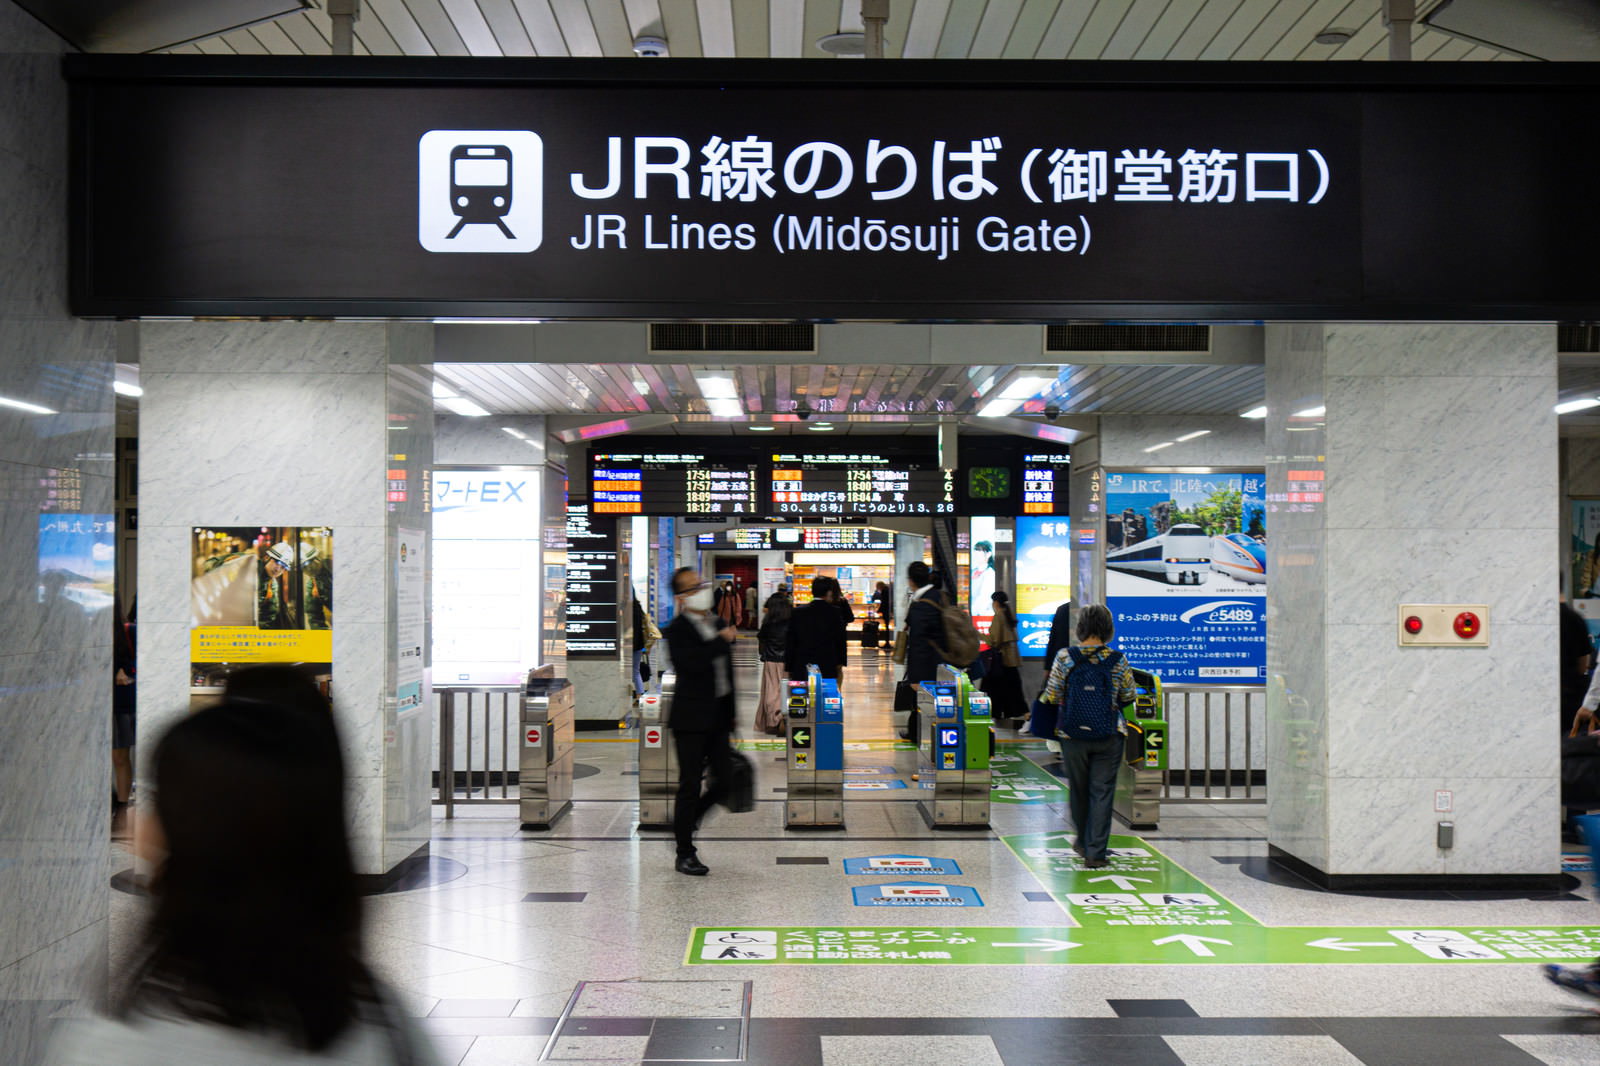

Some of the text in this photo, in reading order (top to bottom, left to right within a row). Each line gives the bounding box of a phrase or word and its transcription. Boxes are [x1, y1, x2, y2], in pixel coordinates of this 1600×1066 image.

[570, 213, 1091, 261] JR Lines (Midōsuji Gate)
[686, 470, 711, 480] 17:54
[750, 470, 756, 480] 1
[847, 471, 871, 480] 17:54
[944, 471, 953, 480] 4
[1108, 475, 1123, 484] JR
[686, 481, 711, 491] 17:57
[750, 481, 756, 491] 1
[847, 481, 871, 491] 18:00
[944, 481, 953, 491] 6
[686, 492, 711, 502] 18:09
[750, 492, 756, 502] 1
[847, 492, 871, 502] 18:04
[944, 492, 953, 502] 4
[686, 503, 711, 513] 18:12
[750, 503, 756, 513] 1
[1118, 613, 1178, 622] きっぷの予約は
[1209, 609, 1254, 622] e5489
[942, 730, 958, 745] IC
[783, 944, 881, 952] 通れる
[785, 951, 952, 960] 自動改札機
